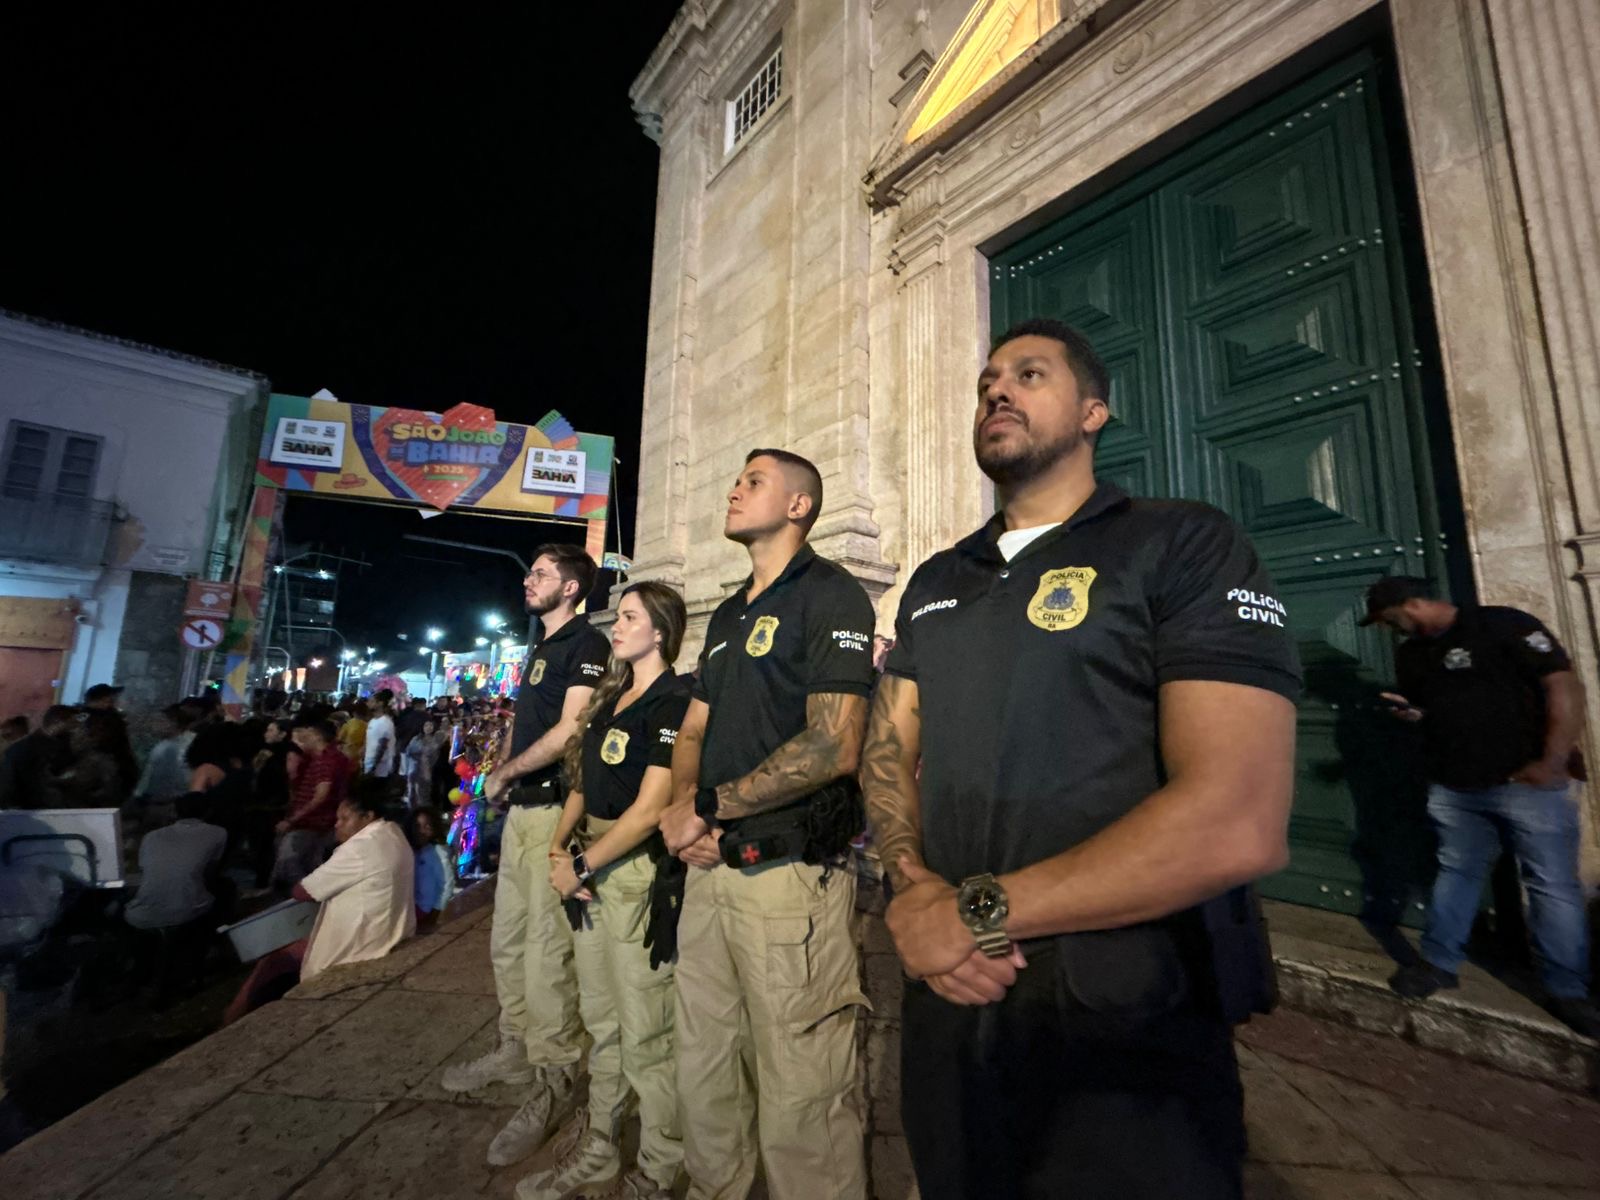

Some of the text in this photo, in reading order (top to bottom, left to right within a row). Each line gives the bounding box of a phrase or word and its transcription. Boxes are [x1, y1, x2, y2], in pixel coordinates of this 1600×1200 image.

[392, 422, 447, 441] SÃO
[282, 441, 333, 457] BAHIA
[406, 441, 499, 463] BAHIA
[532, 469, 576, 484] BAHIA
[1042, 613, 1067, 622] CIVIL
[1237, 606, 1284, 627] CIVIL
[839, 640, 864, 651] CIVIL
[583, 669, 600, 677] CIVIL
[660, 735, 675, 745] CIVI
